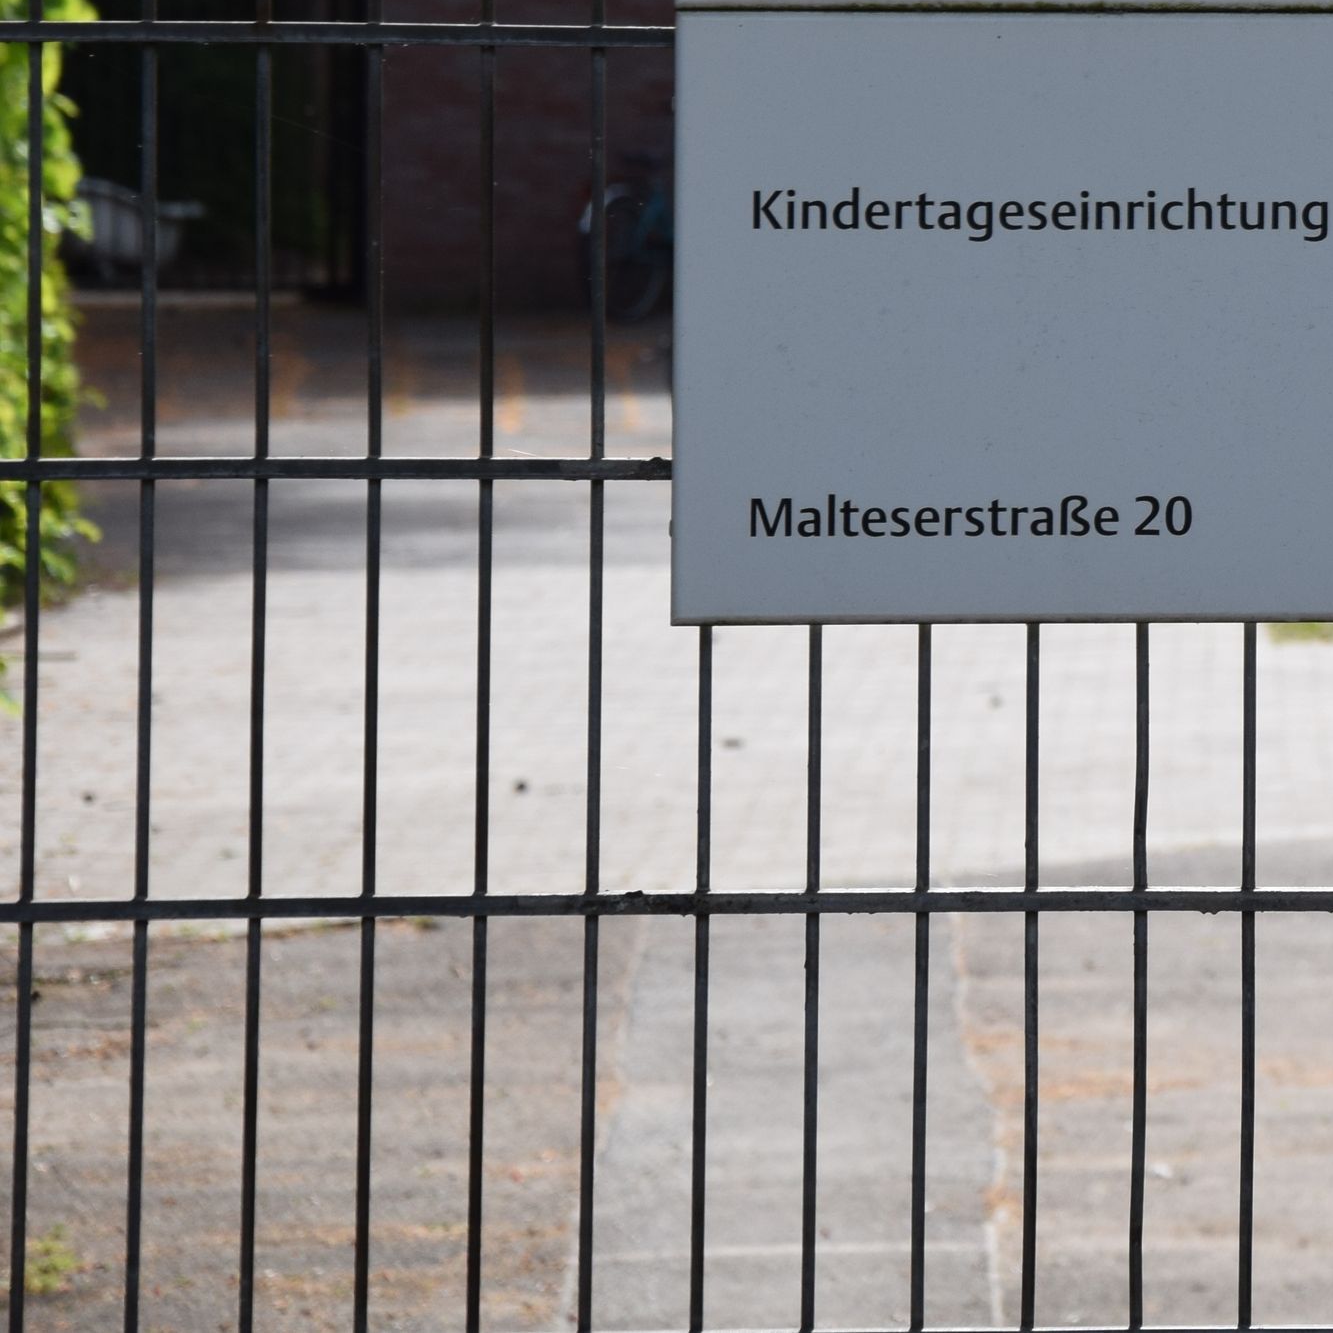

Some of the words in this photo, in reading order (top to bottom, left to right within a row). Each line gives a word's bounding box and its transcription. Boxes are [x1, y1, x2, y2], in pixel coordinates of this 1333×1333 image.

[752, 186, 1330, 243] Kindertageseinrichtung
[749, 493, 1120, 538] Malteserstraße
[1134, 495, 1193, 537] 20
